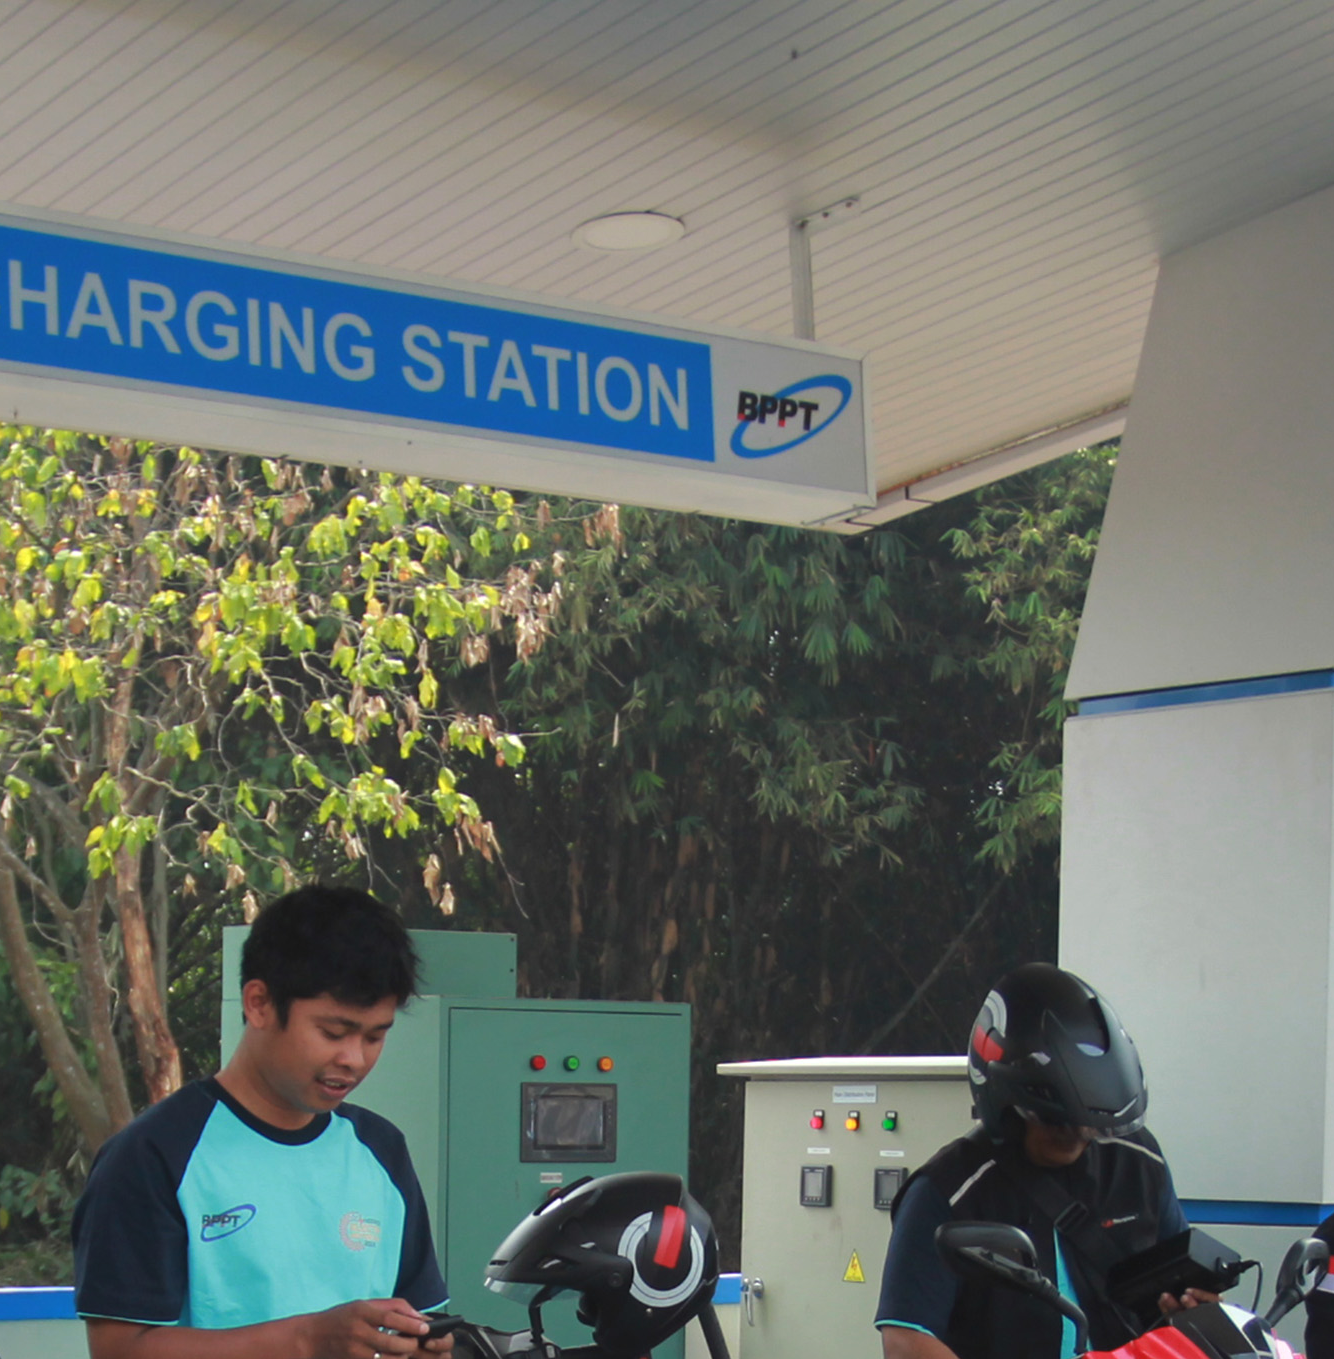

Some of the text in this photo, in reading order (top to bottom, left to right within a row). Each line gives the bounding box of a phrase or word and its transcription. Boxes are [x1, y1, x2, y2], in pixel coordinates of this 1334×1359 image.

[402, 323, 689, 431] STATION
[737, 389, 820, 431] BPPT
[202, 1213, 242, 1228] BPPT
